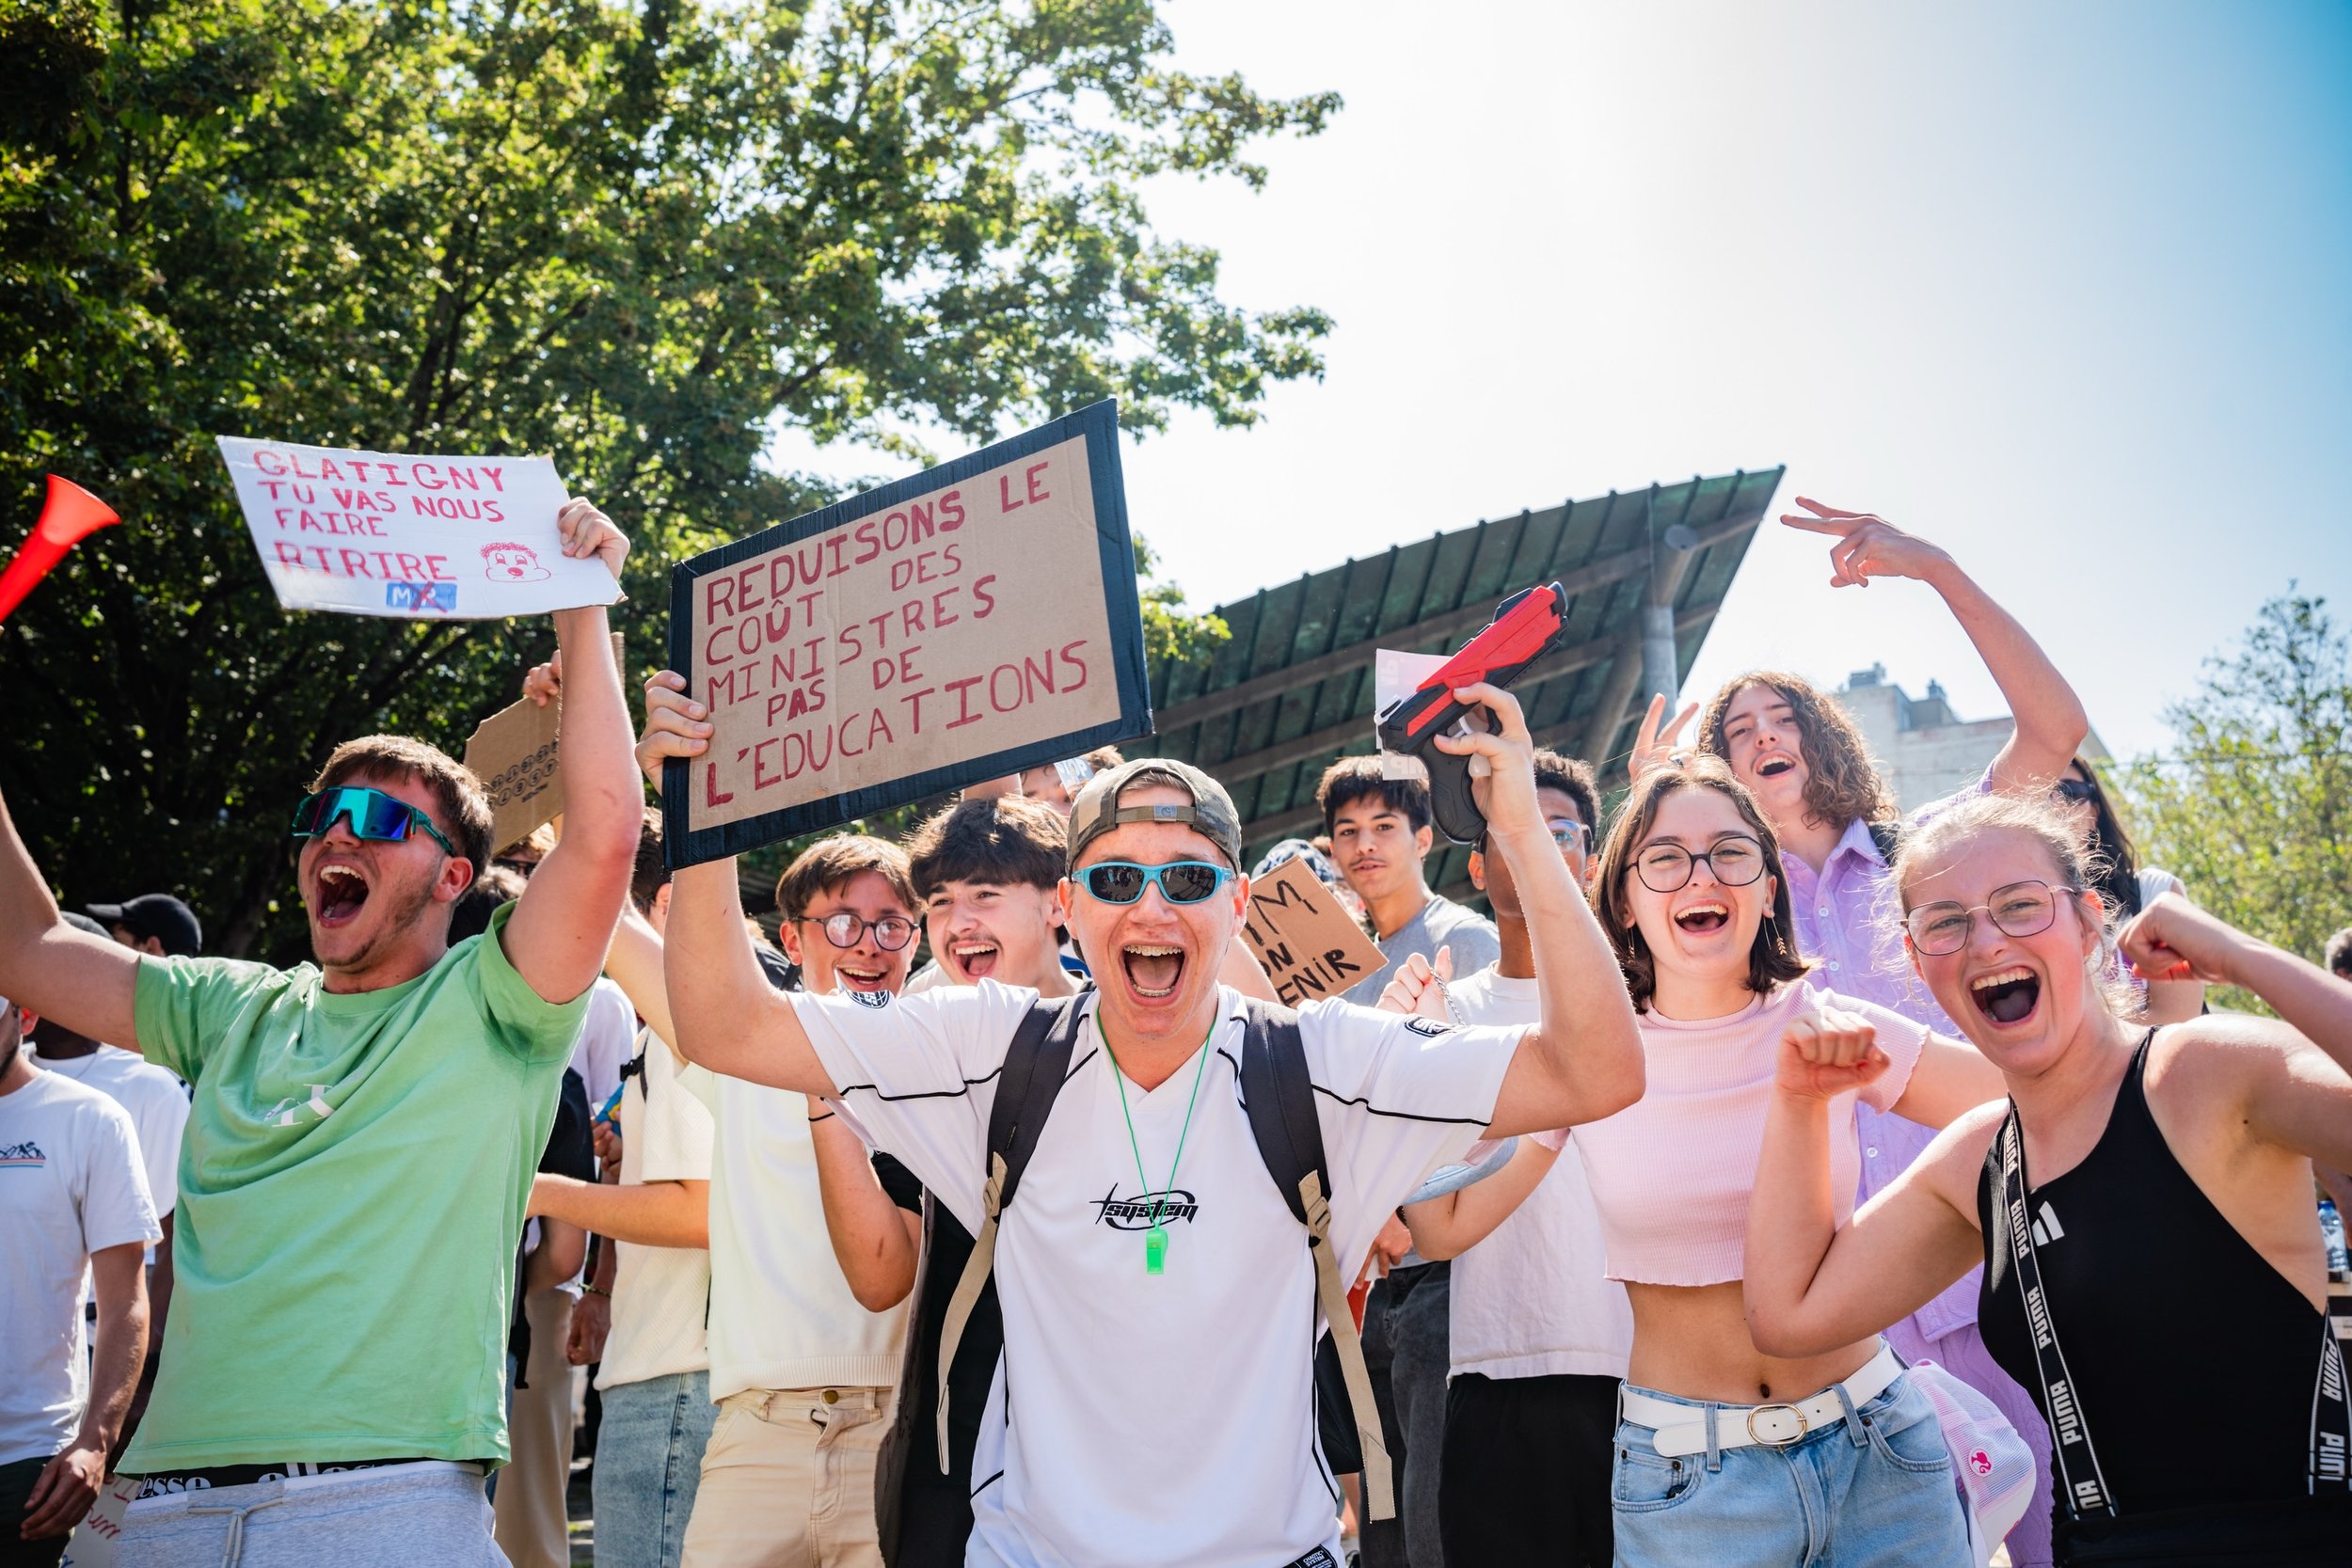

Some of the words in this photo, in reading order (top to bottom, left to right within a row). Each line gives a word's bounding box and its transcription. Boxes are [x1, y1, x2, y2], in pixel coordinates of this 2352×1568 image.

[253, 451, 504, 492] GLATIGNY
[257, 481, 315, 504] TU
[332, 487, 397, 513] VAS
[412, 495, 505, 522] NOUS
[275, 508, 389, 536] FAIRE
[707, 490, 965, 626] REDUISONS
[1000, 461, 1050, 513] LE
[706, 591, 824, 666] COÛT
[892, 543, 961, 592] DES
[708, 574, 996, 713] MINISTRES
[767, 678, 826, 727] PAS
[872, 645, 924, 690] DE
[707, 640, 1088, 808] L'EDUCATIONS
[2010, 1198, 2031, 1260] PUMA
[2026, 1285, 2052, 1351] PUMA
[2321, 1337, 2343, 1402] PUMA
[2049, 1379, 2083, 1446] PUMA
